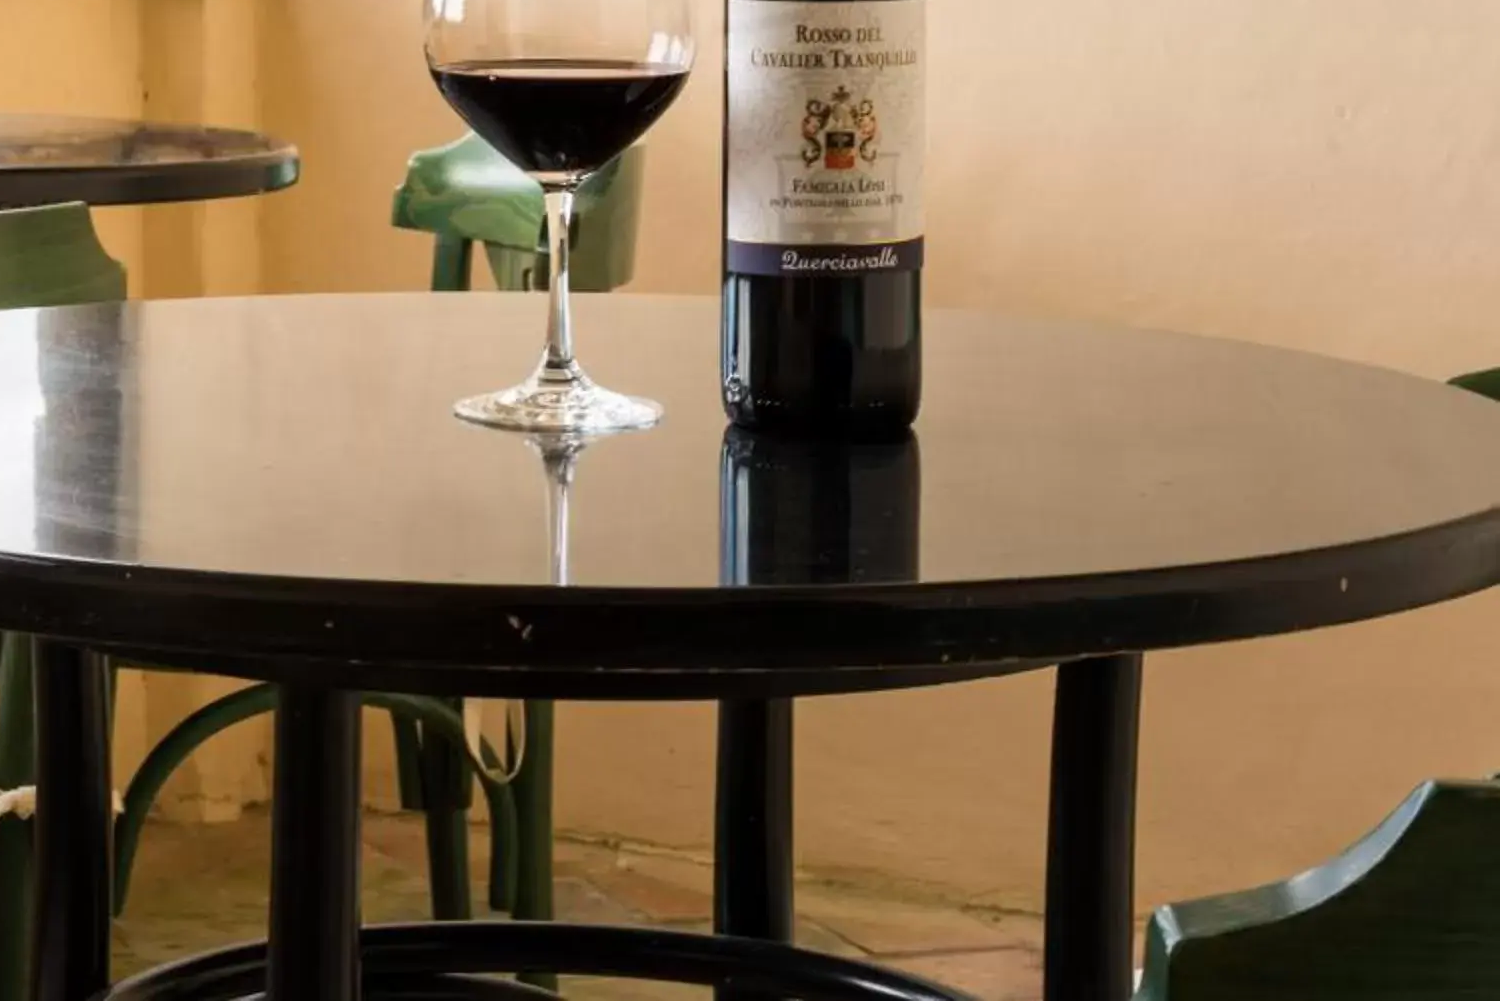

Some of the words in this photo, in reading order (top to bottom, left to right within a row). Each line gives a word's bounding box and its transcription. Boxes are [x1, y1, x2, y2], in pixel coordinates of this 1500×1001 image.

[795, 24, 851, 44] ROSSO
[856, 27, 884, 43] DEL
[750, 47, 826, 69] CAVALIER
